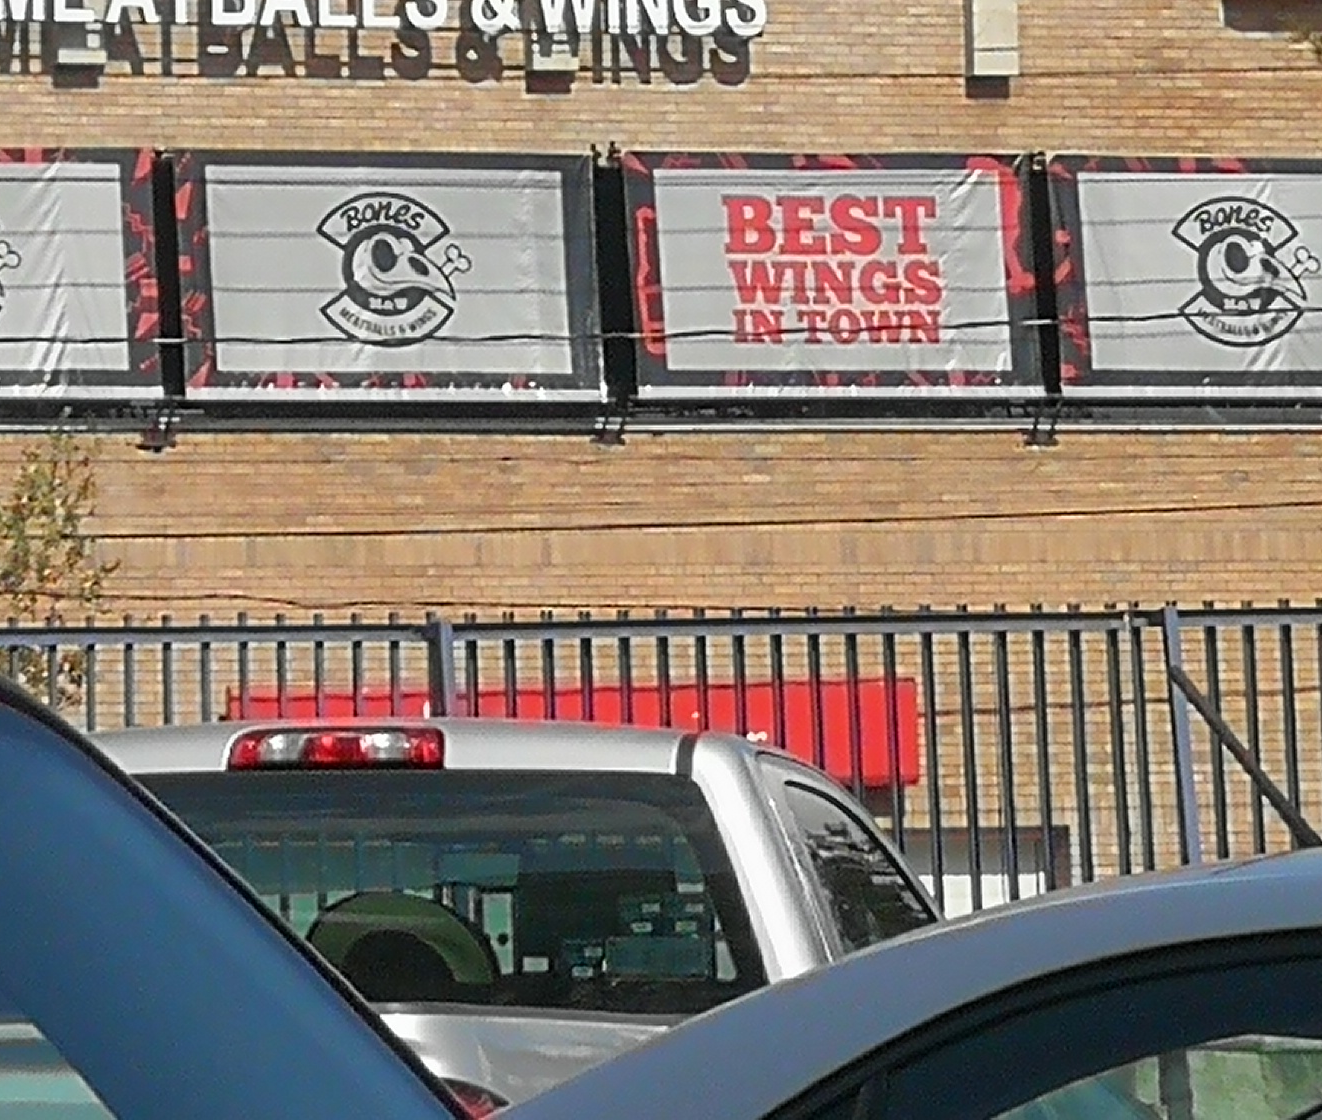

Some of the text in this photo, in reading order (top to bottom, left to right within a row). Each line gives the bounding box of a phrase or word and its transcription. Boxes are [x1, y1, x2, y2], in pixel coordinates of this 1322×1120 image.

[721, 194, 937, 255] BEST
[728, 259, 943, 305] WINGS
[732, 307, 942, 345] IN TOWN
